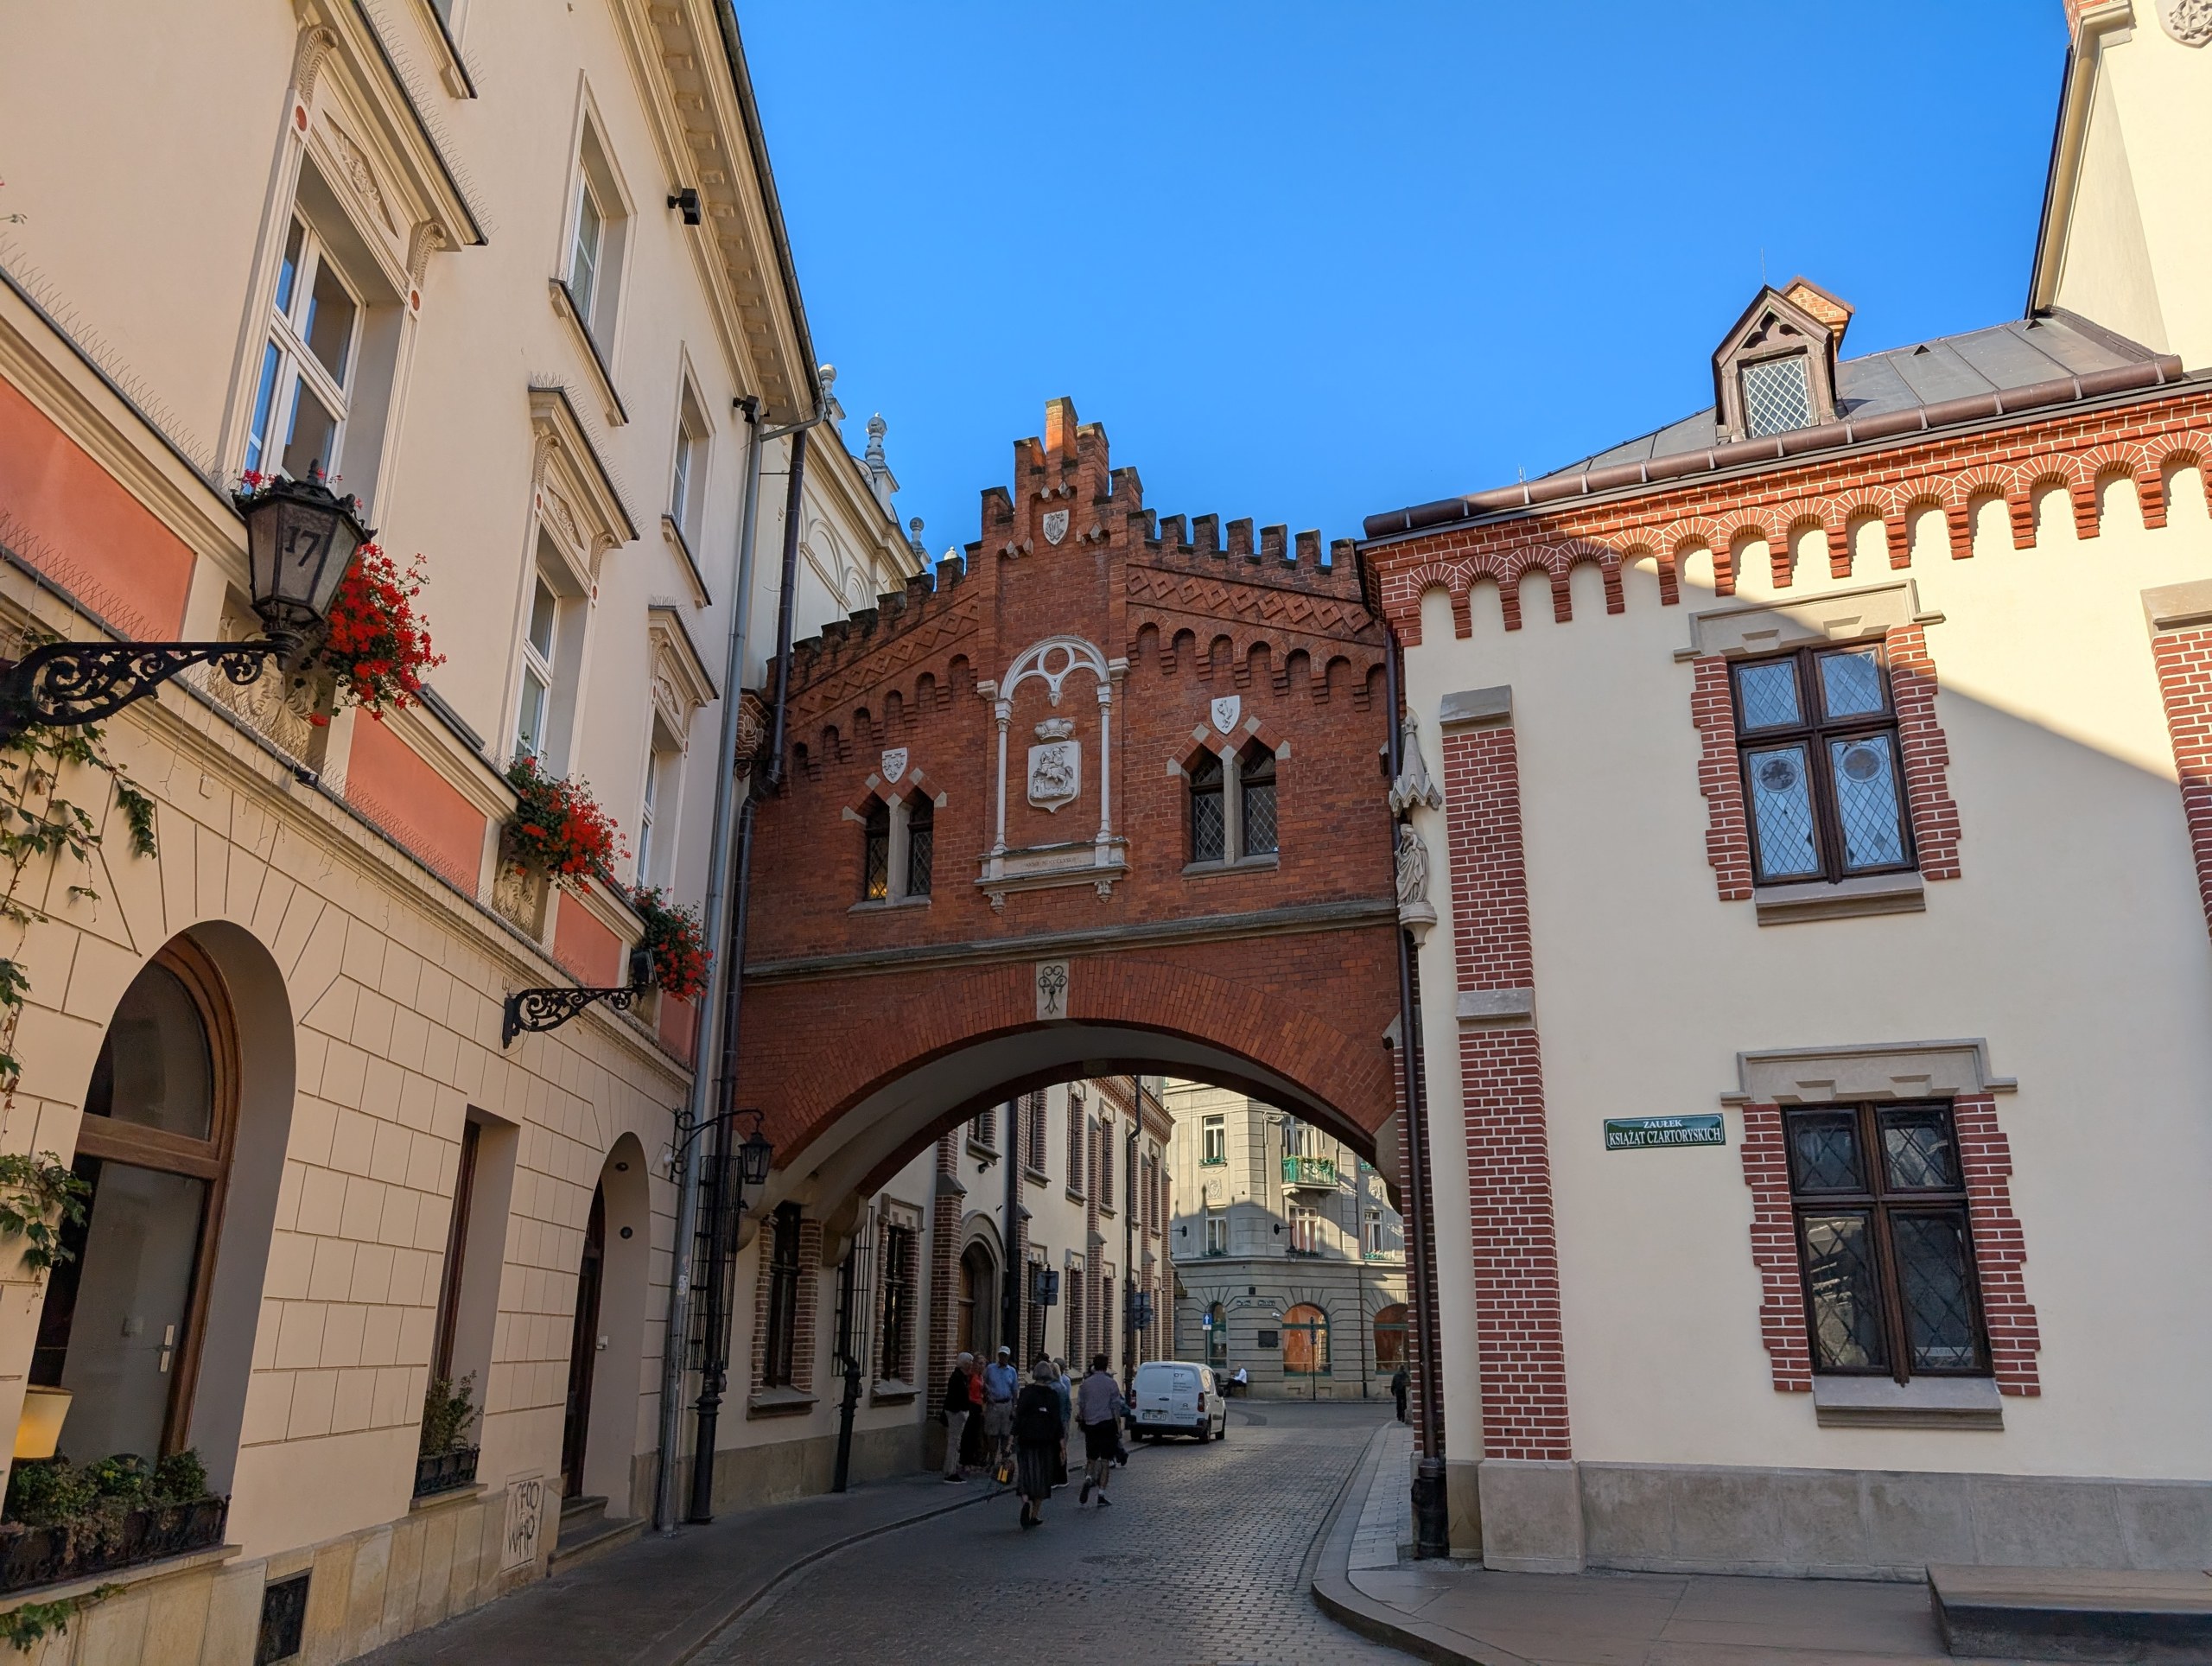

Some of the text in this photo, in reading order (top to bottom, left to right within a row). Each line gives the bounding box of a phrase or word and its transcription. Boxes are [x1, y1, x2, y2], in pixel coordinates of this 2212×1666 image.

[285, 525, 321, 567] 17
[1643, 1120, 1682, 1129] ZAUŁEK
[1647, 1128, 1721, 1143] CZARTORYSKICH
